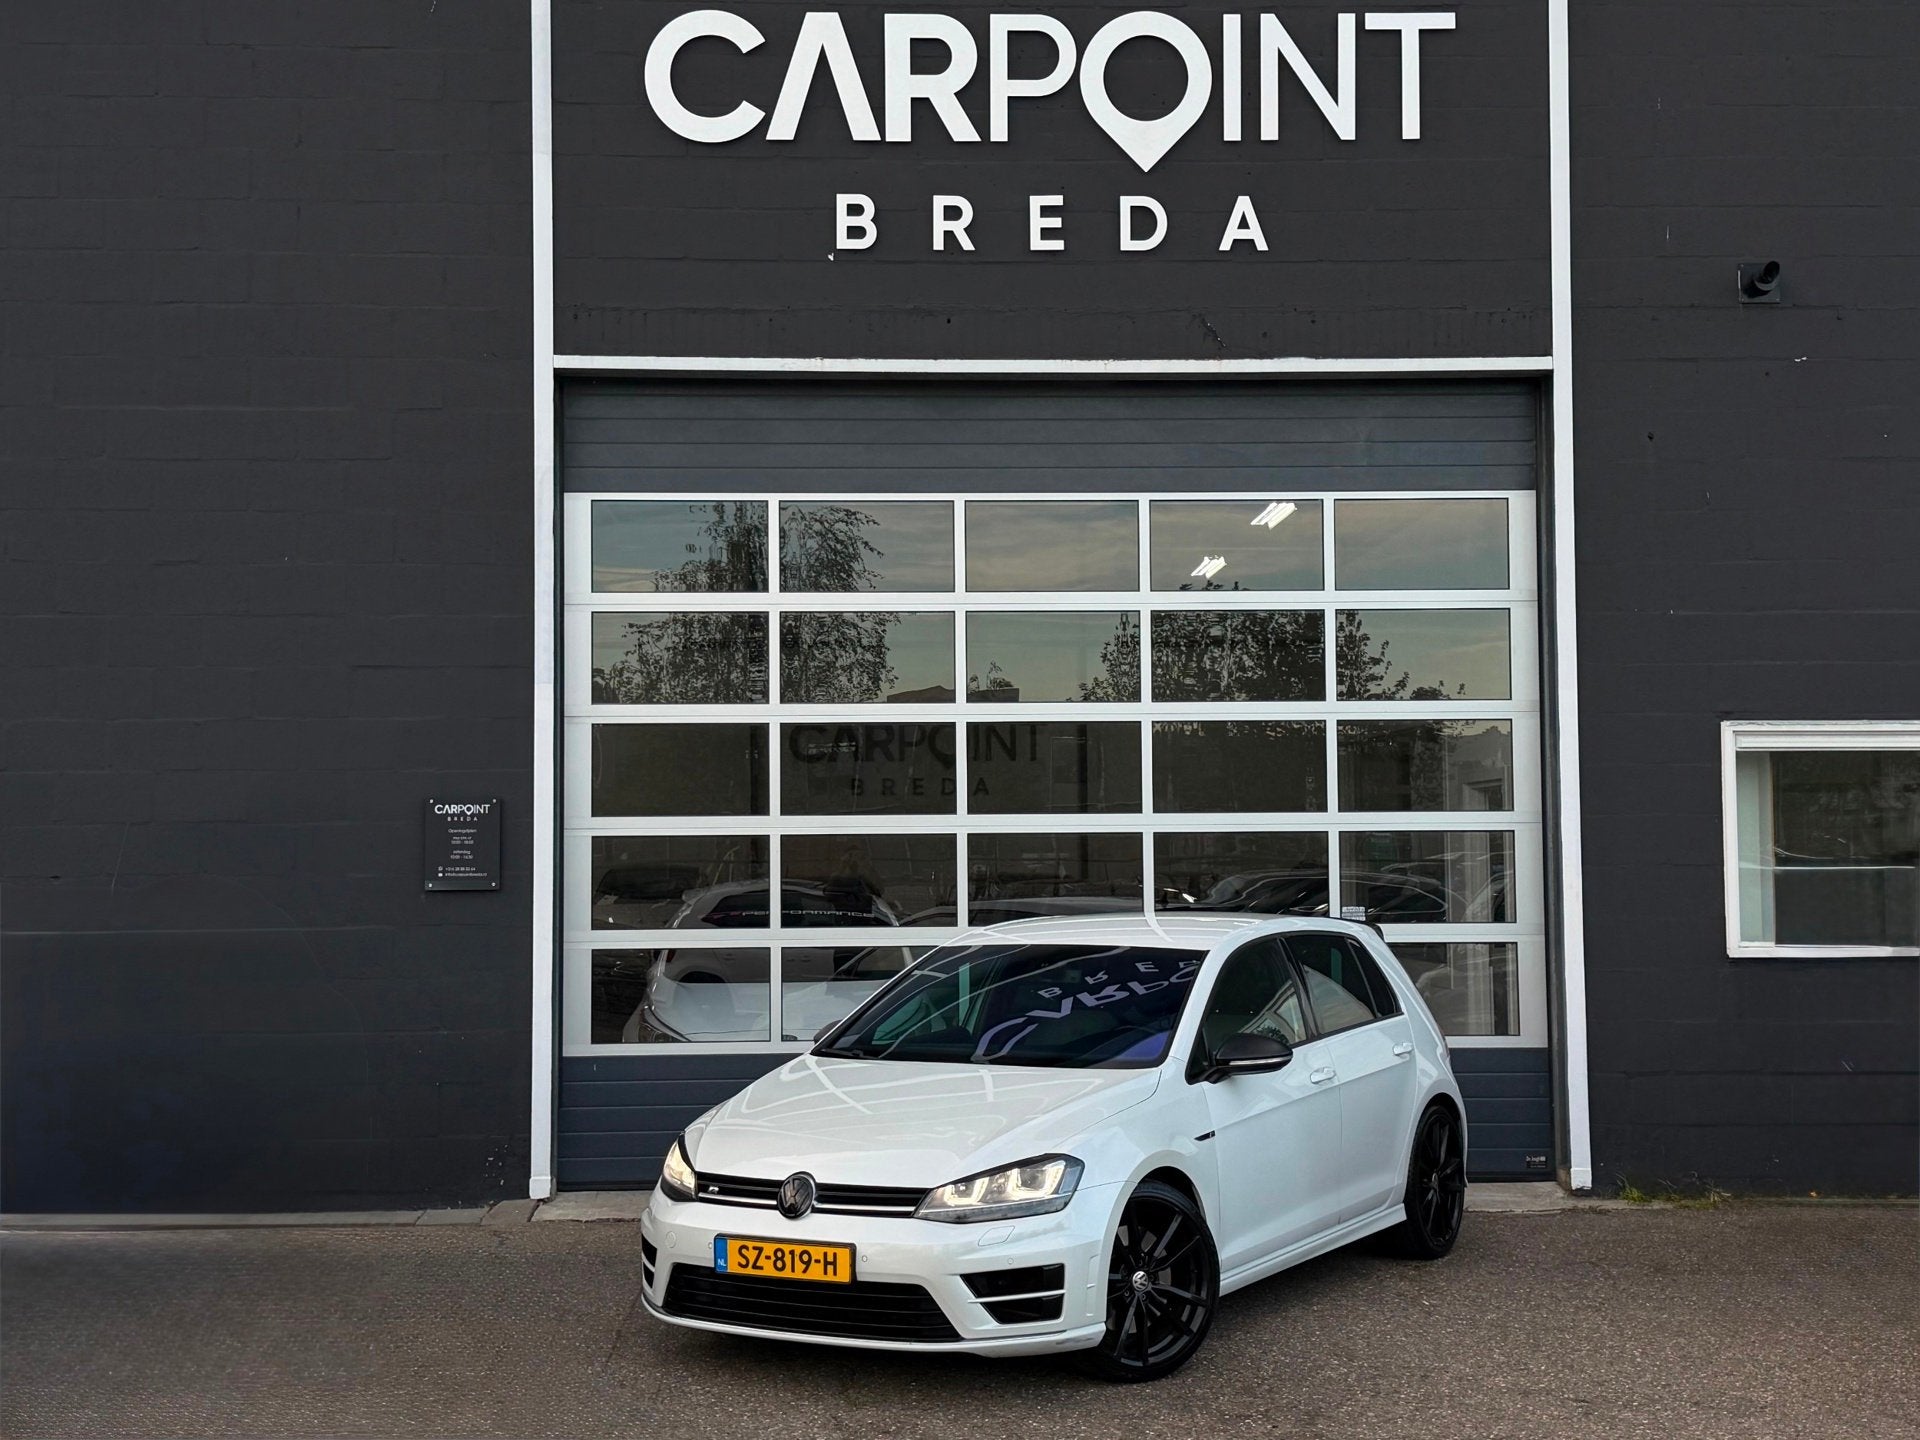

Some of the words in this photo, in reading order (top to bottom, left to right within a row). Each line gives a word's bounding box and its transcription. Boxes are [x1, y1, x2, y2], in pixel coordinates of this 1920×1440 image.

[643, 9, 1457, 173] CARPOINT
[835, 193, 1269, 252] BREDA
[851, 777, 990, 796] BREDA
[434, 804, 490, 815] CARPOINT
[742, 910, 875, 918] PEORMANCE
[717, 1258, 727, 1267] NL
[737, 1244, 838, 1277] SZ-819-H
